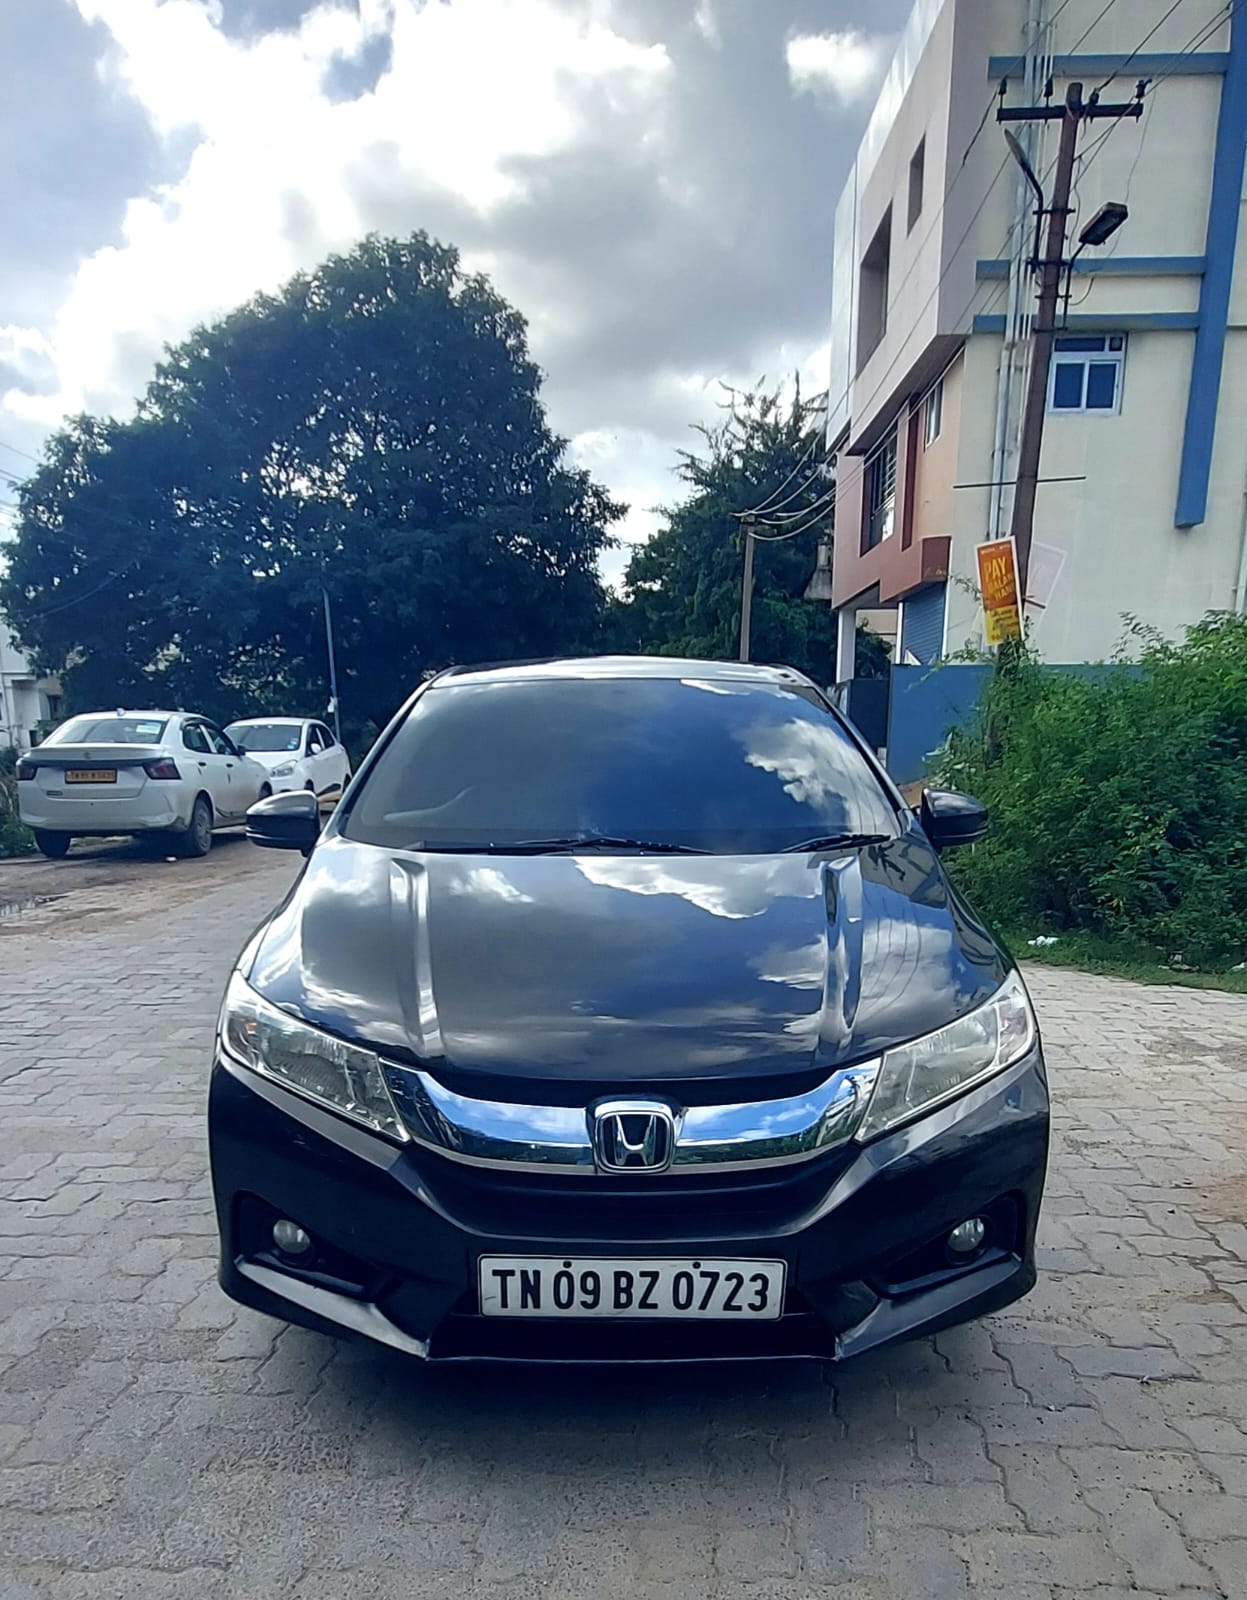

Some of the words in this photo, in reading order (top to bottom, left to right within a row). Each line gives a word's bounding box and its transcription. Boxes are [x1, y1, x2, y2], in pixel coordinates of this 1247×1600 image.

[984, 556, 1007, 583] PAY
[491, 1269, 541, 1310] TN
[553, 1270, 601, 1310] 09
[613, 1270, 660, 1310] BZ
[672, 1270, 770, 1312] 0723
